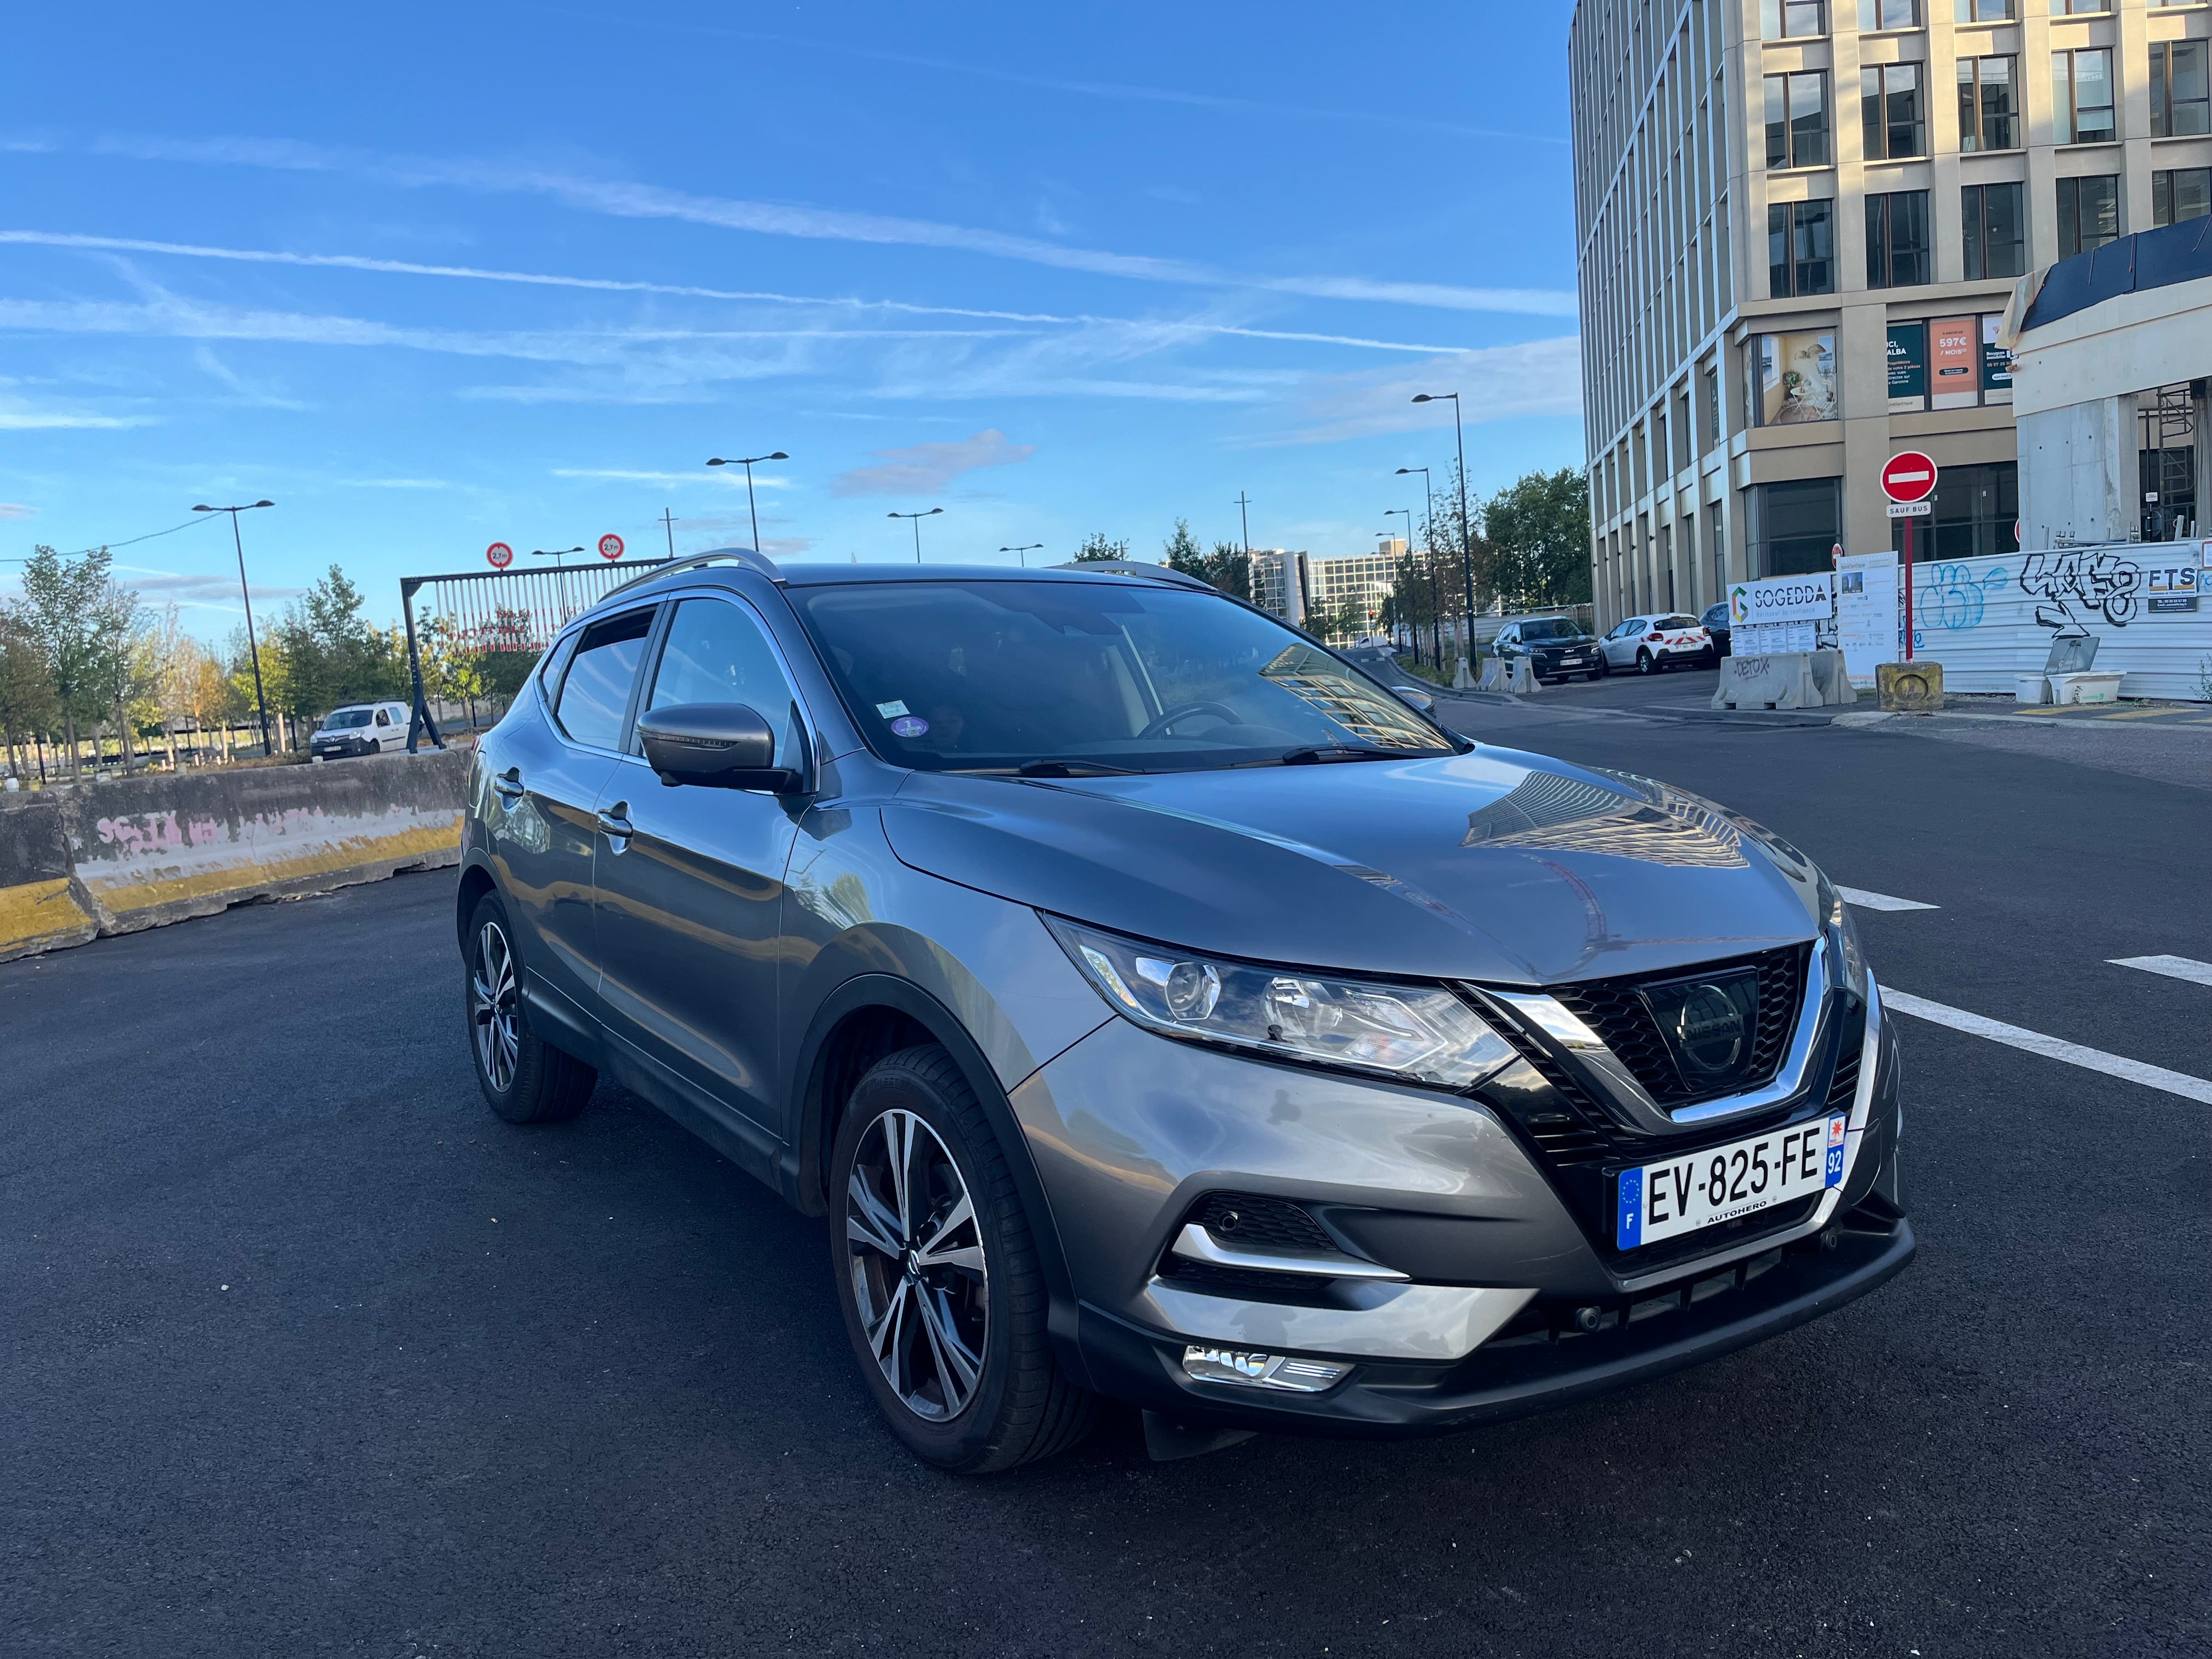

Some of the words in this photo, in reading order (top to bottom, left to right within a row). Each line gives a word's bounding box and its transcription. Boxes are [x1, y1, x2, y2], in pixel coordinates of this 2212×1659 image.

[1887, 347, 1906, 356] ALBA
[1939, 337, 1967, 347] 597€
[2149, 567, 2195, 590] FTS
[1755, 583, 1827, 608] SOGEDDA
[1626, 1212, 1634, 1229] F
[1649, 1126, 1820, 1226] EV-825-FE
[1827, 1150, 1842, 1175] 92
[1707, 1200, 1767, 1224] AUTOHERO
